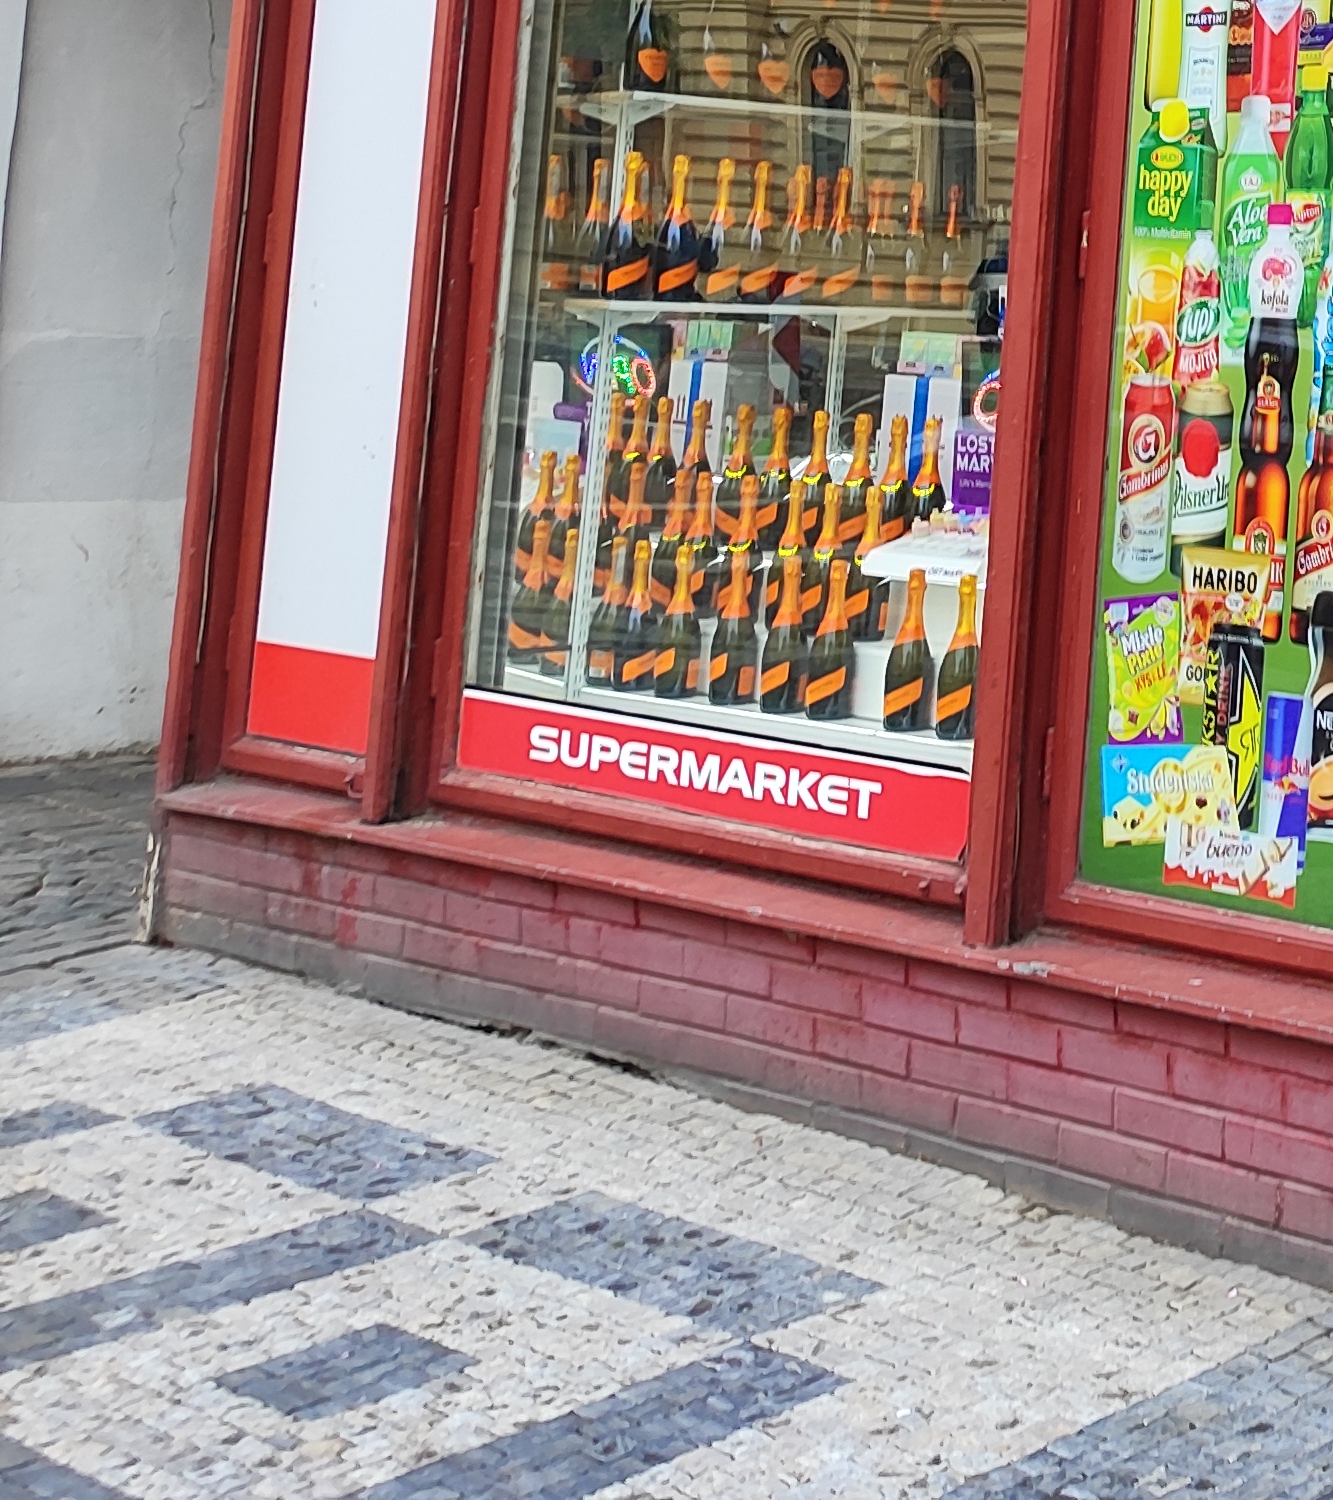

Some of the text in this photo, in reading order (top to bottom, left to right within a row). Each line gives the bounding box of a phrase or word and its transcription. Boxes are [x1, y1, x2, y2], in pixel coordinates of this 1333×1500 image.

[1186, 12, 1226, 26] MARTINI
[1139, 163, 1194, 199] happy
[1147, 192, 1184, 223] day
[1260, 288, 1290, 310] kofola
[1178, 348, 1218, 374] MOJITO
[1192, 565, 1258, 594] HARIBO
[528, 725, 883, 820] SUPERMARKET
[1206, 834, 1253, 859] bueno
